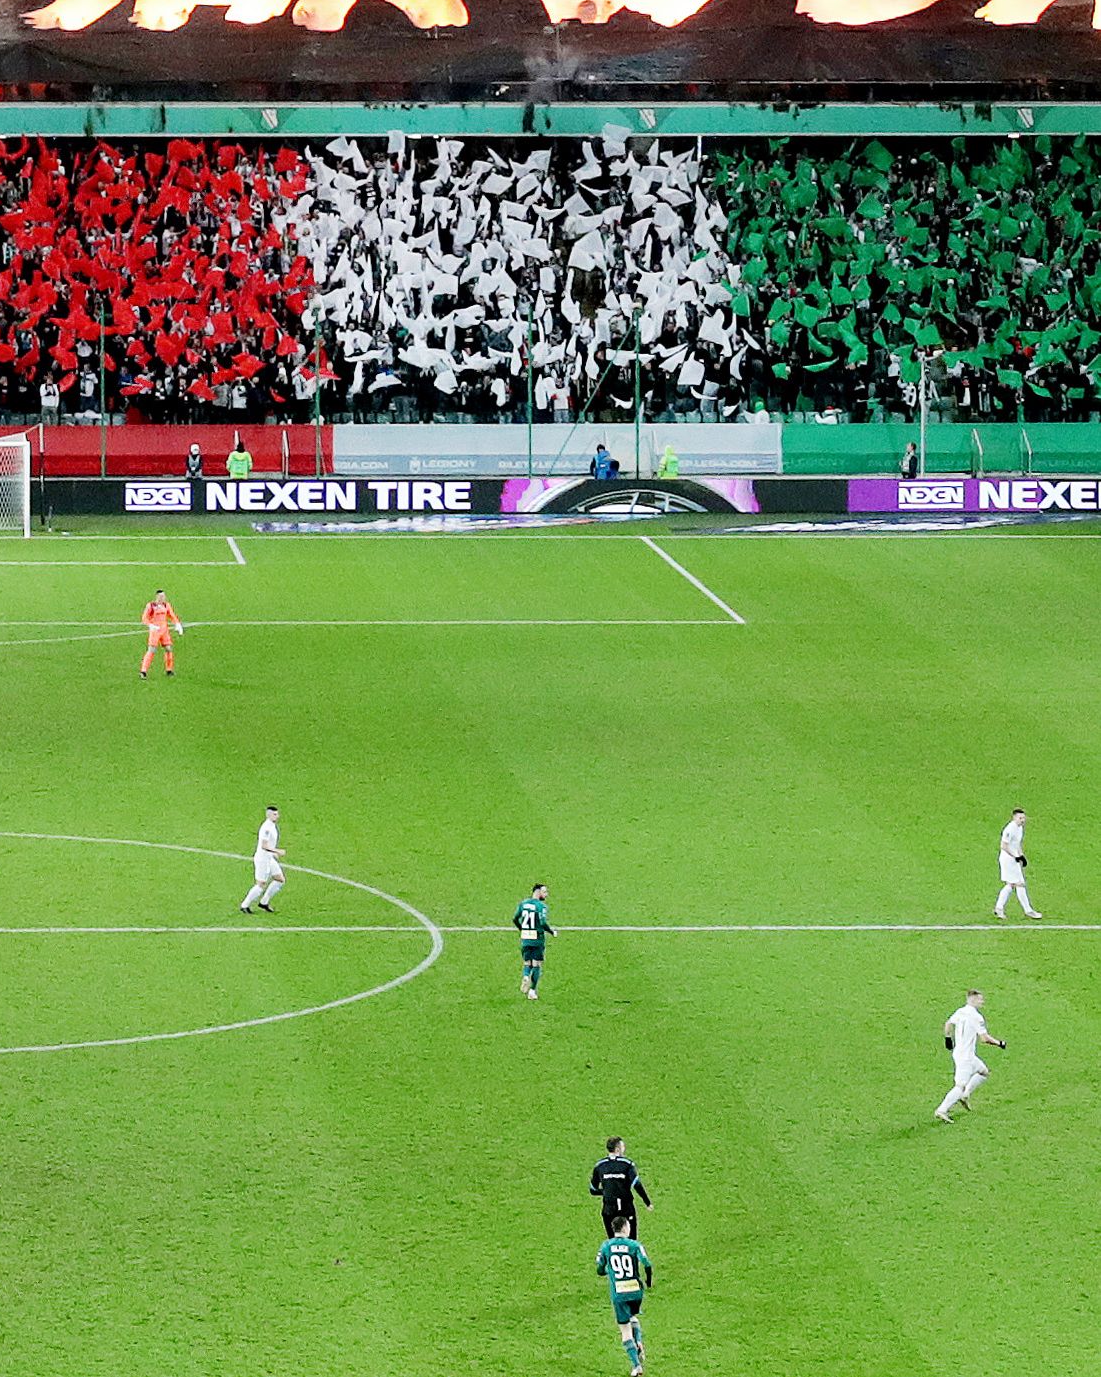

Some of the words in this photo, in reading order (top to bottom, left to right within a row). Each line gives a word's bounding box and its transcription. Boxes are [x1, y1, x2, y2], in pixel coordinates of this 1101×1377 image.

[206, 481, 356, 510] NEXEN
[368, 481, 471, 510] TIRE
[979, 480, 1101, 509] NEXE
[521, 910, 536, 929] 21
[610, 1254, 634, 1279] 99
